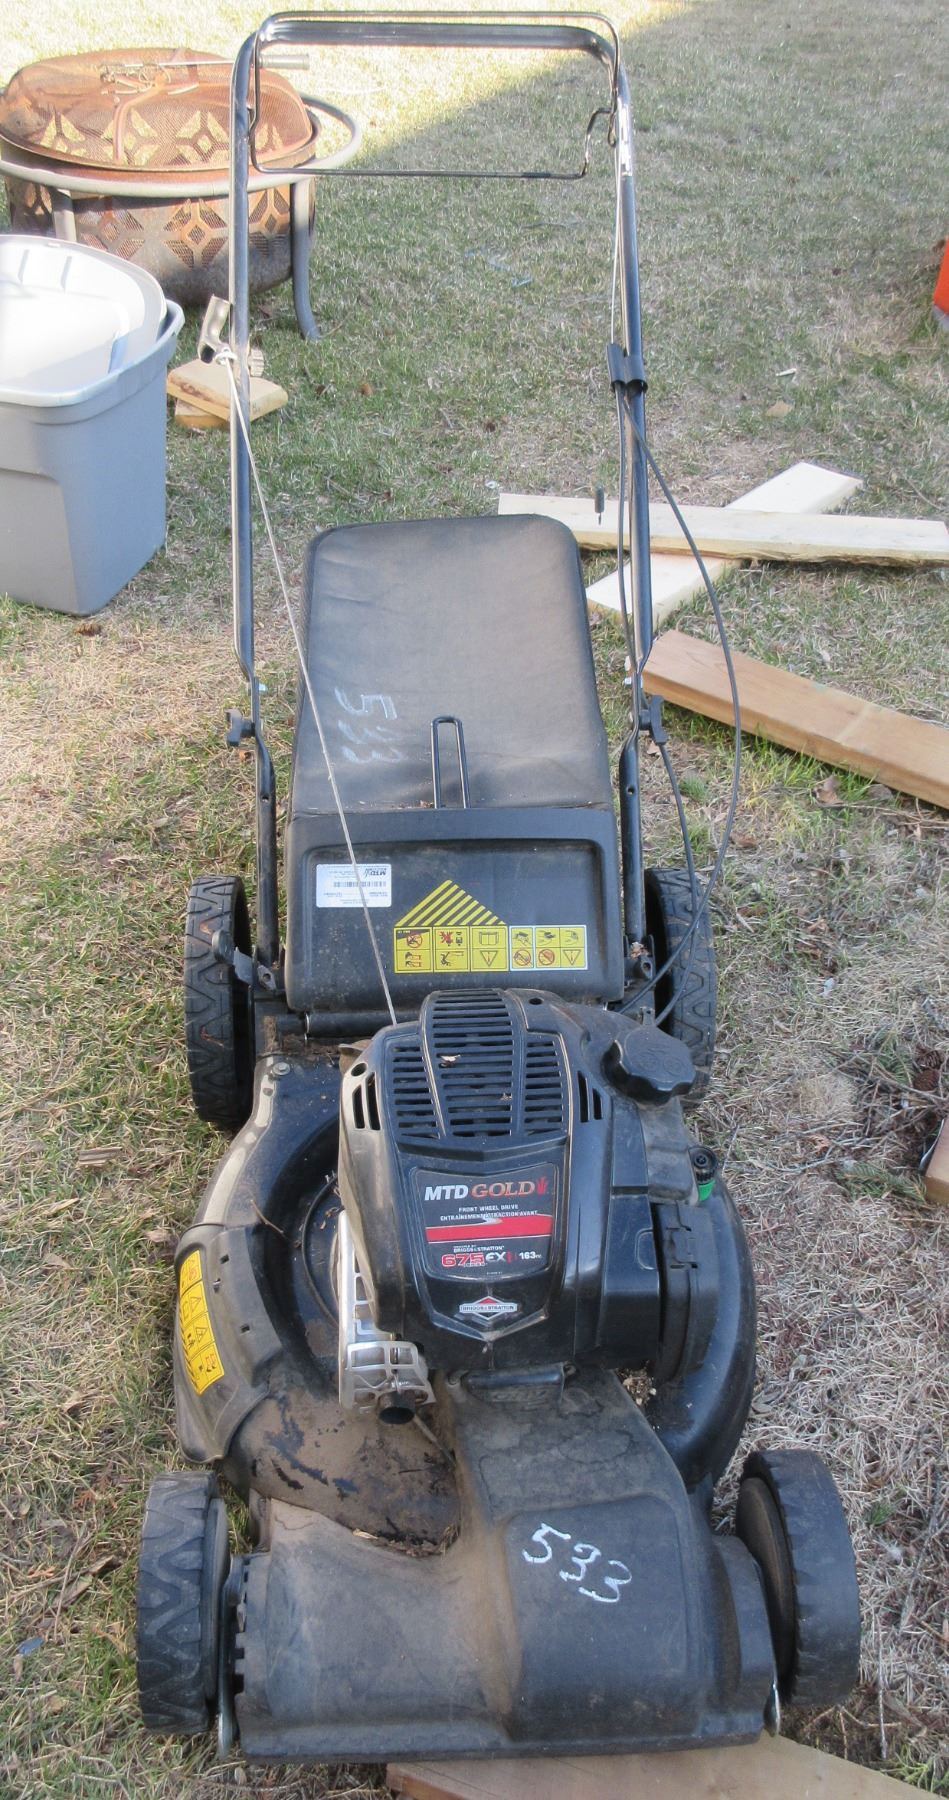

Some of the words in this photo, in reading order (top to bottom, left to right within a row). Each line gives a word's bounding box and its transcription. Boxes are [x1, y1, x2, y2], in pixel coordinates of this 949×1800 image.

[424, 1184, 469, 1201] MTD
[471, 1181, 536, 1198] GOLD
[522, 1523, 632, 1603] 533
